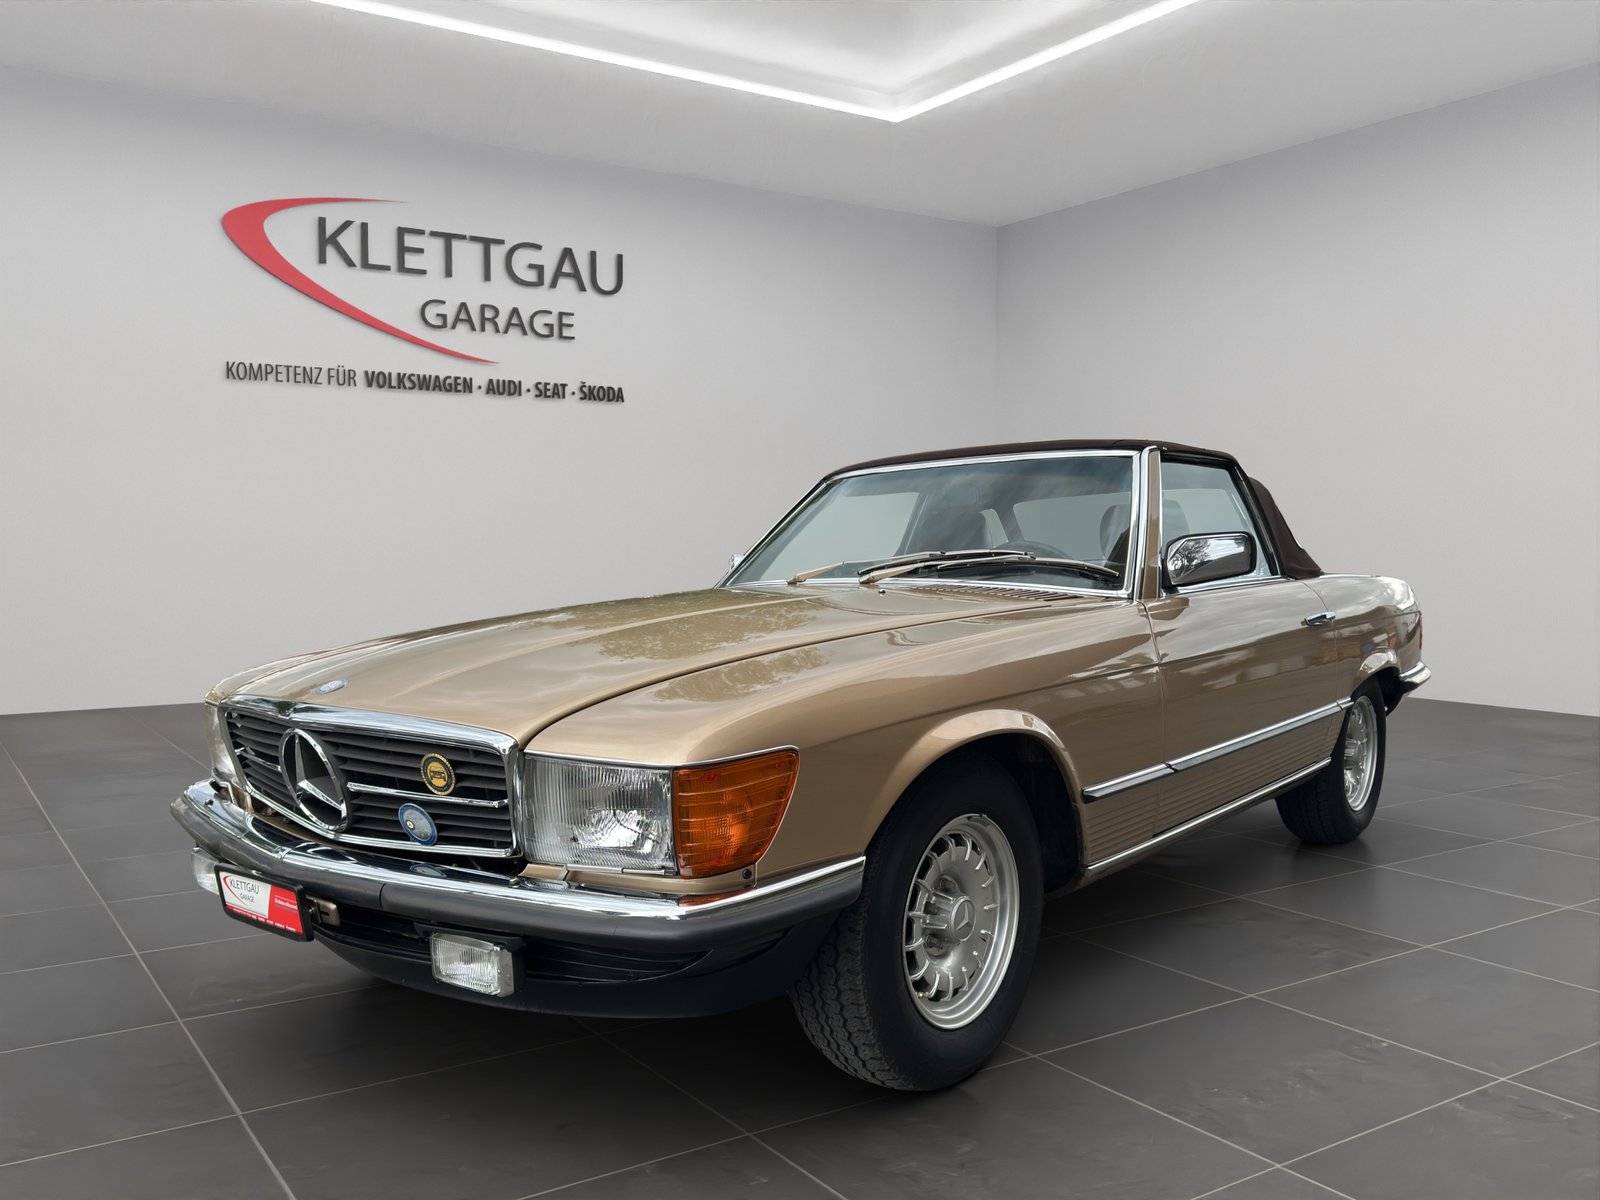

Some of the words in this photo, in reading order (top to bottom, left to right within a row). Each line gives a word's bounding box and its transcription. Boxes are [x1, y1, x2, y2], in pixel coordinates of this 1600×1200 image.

[317, 216, 623, 295] KLETTGAU
[420, 298, 576, 340] GARAGE
[225, 361, 323, 386] KOMPETENZ
[326, 367, 357, 387] FÜR
[364, 370, 473, 394] VOLKSWAGEN
[485, 378, 522, 397] AUDI
[534, 382, 568, 400] SEAT
[578, 381, 625, 403] ŠKODA
[229, 878, 260, 895] KLETTGAU
